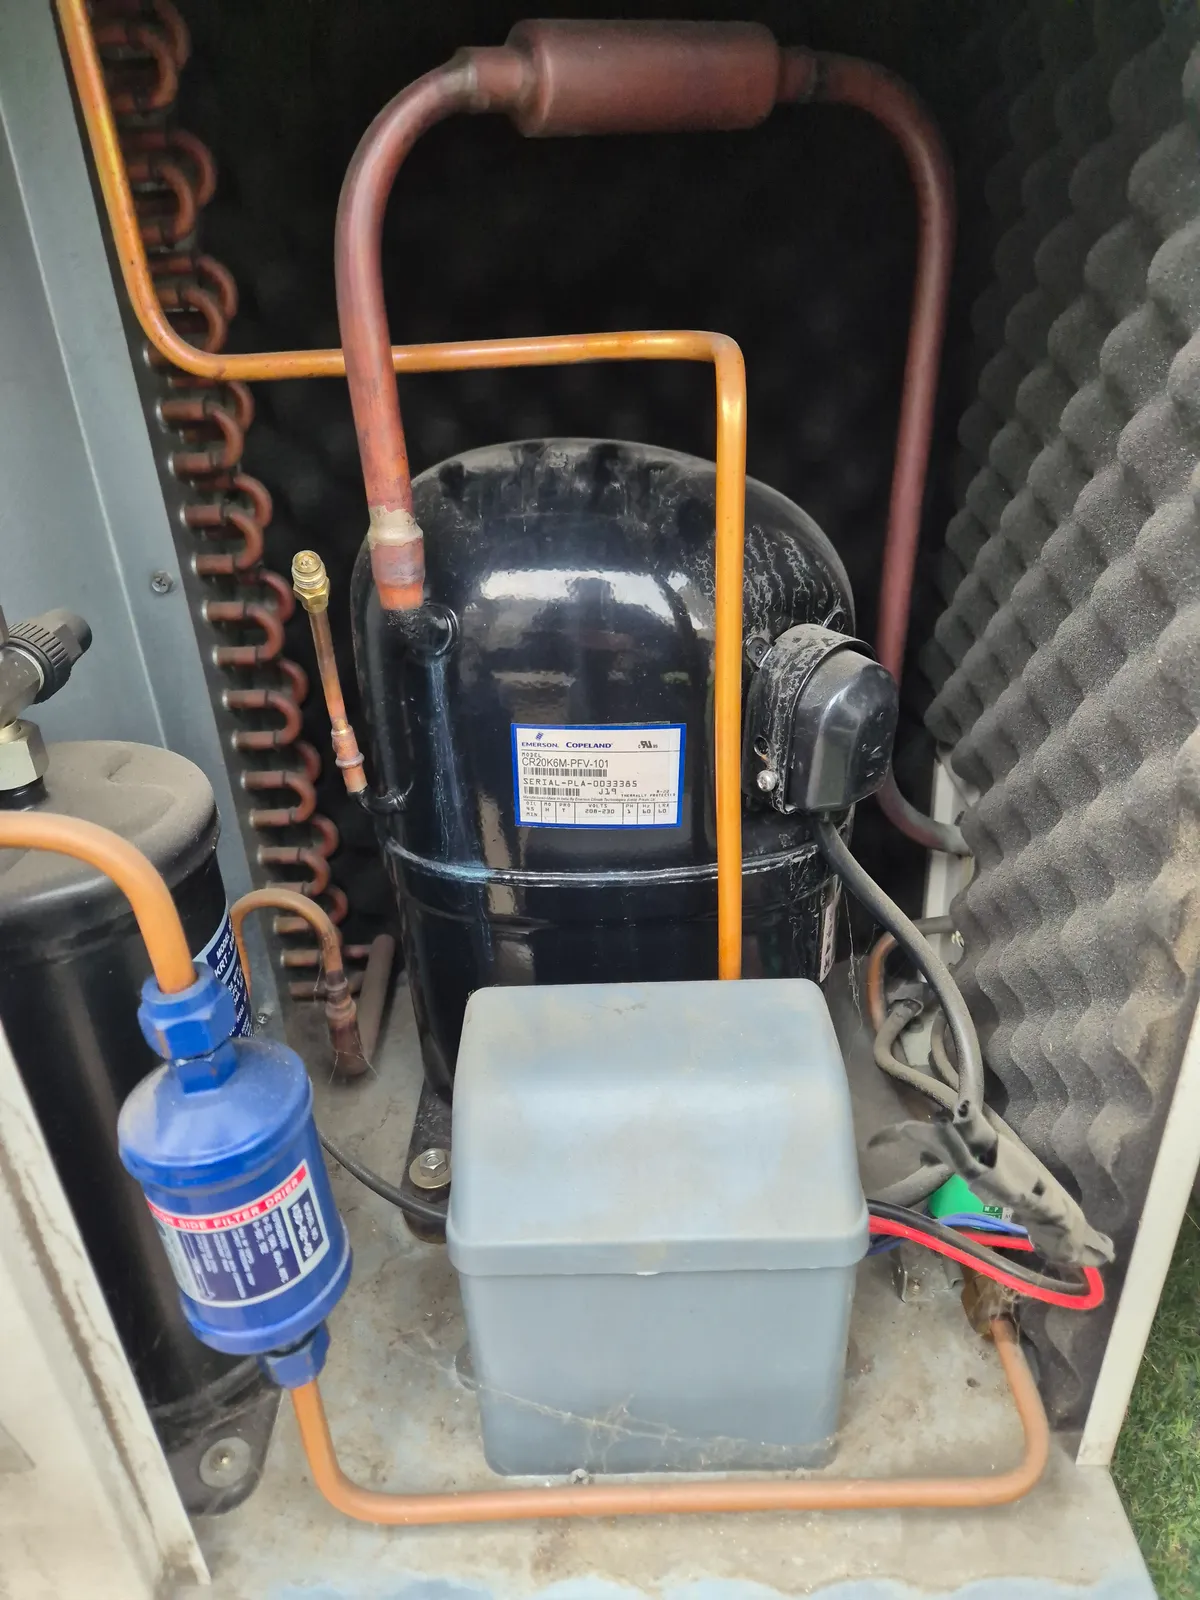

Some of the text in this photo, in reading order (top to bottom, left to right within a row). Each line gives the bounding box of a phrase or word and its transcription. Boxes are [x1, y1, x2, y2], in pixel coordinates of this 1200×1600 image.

[522, 757, 608, 768] CR20K6M-PFV-101
[178, 1178, 298, 1230] SIDE FILTER DRIER
